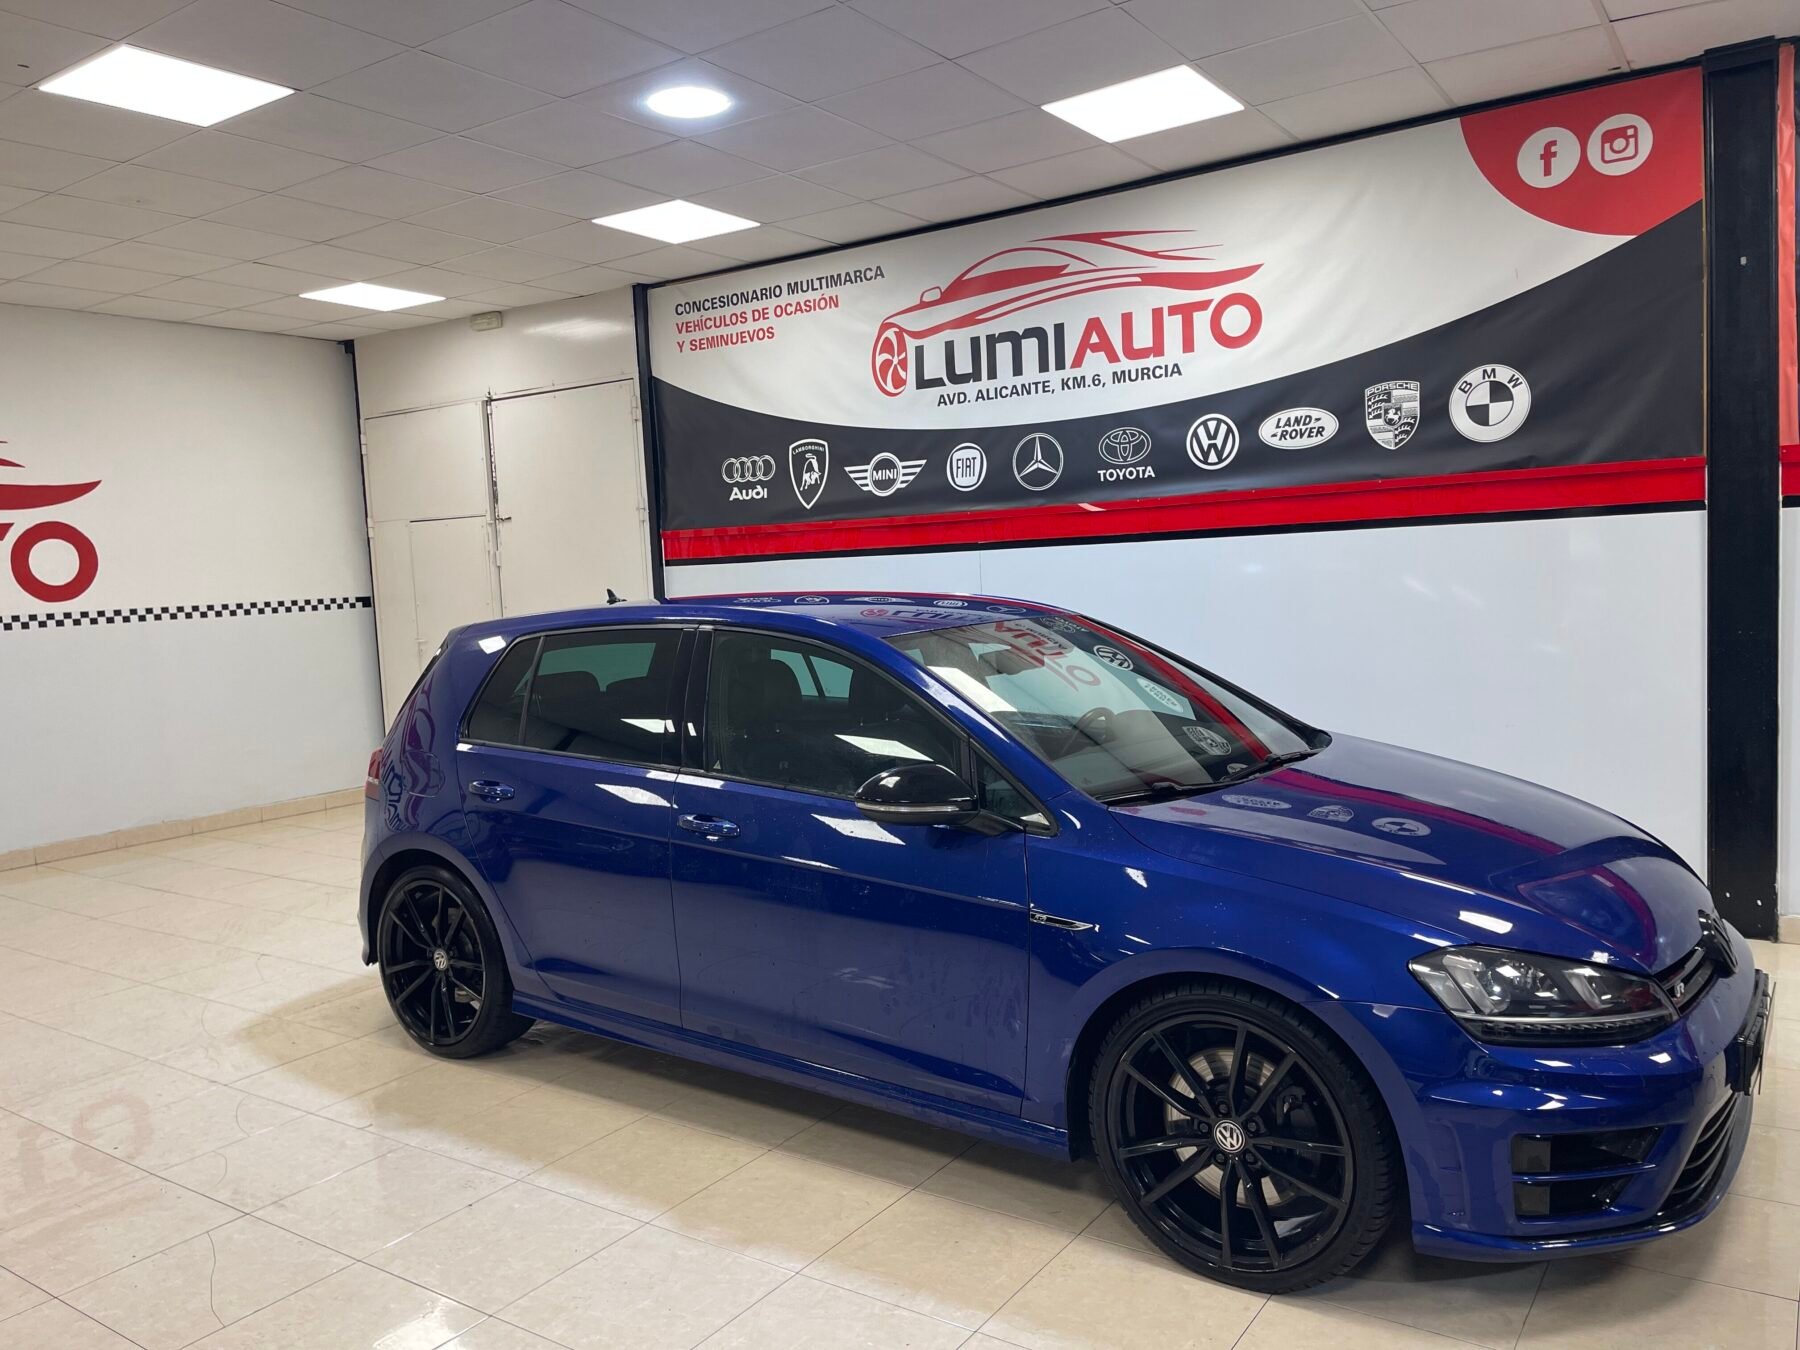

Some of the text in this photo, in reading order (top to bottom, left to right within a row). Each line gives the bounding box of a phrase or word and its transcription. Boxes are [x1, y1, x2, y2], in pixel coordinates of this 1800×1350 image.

[675, 265, 885, 316] CONCESIONARIO MULTIMARCA
[675, 294, 840, 334] VEHÍCULOS DE OCASIÓN
[676, 326, 775, 353] Y SEMINUEVOS
[937, 362, 1183, 407] AVD. ALICANTE, KM.6, MURCIA
[1367, 382, 1418, 397] PORSCHE
[1458, 367, 1524, 395] BMW
[1275, 415, 1312, 430] LAND
[1279, 426, 1326, 441] ROVER
[792, 445, 825, 455] LAMBORGHINI
[872, 468, 897, 481] MINI
[955, 455, 977, 479] FIAT
[1097, 465, 1155, 482] TOYOTA
[729, 485, 768, 501] Audi
